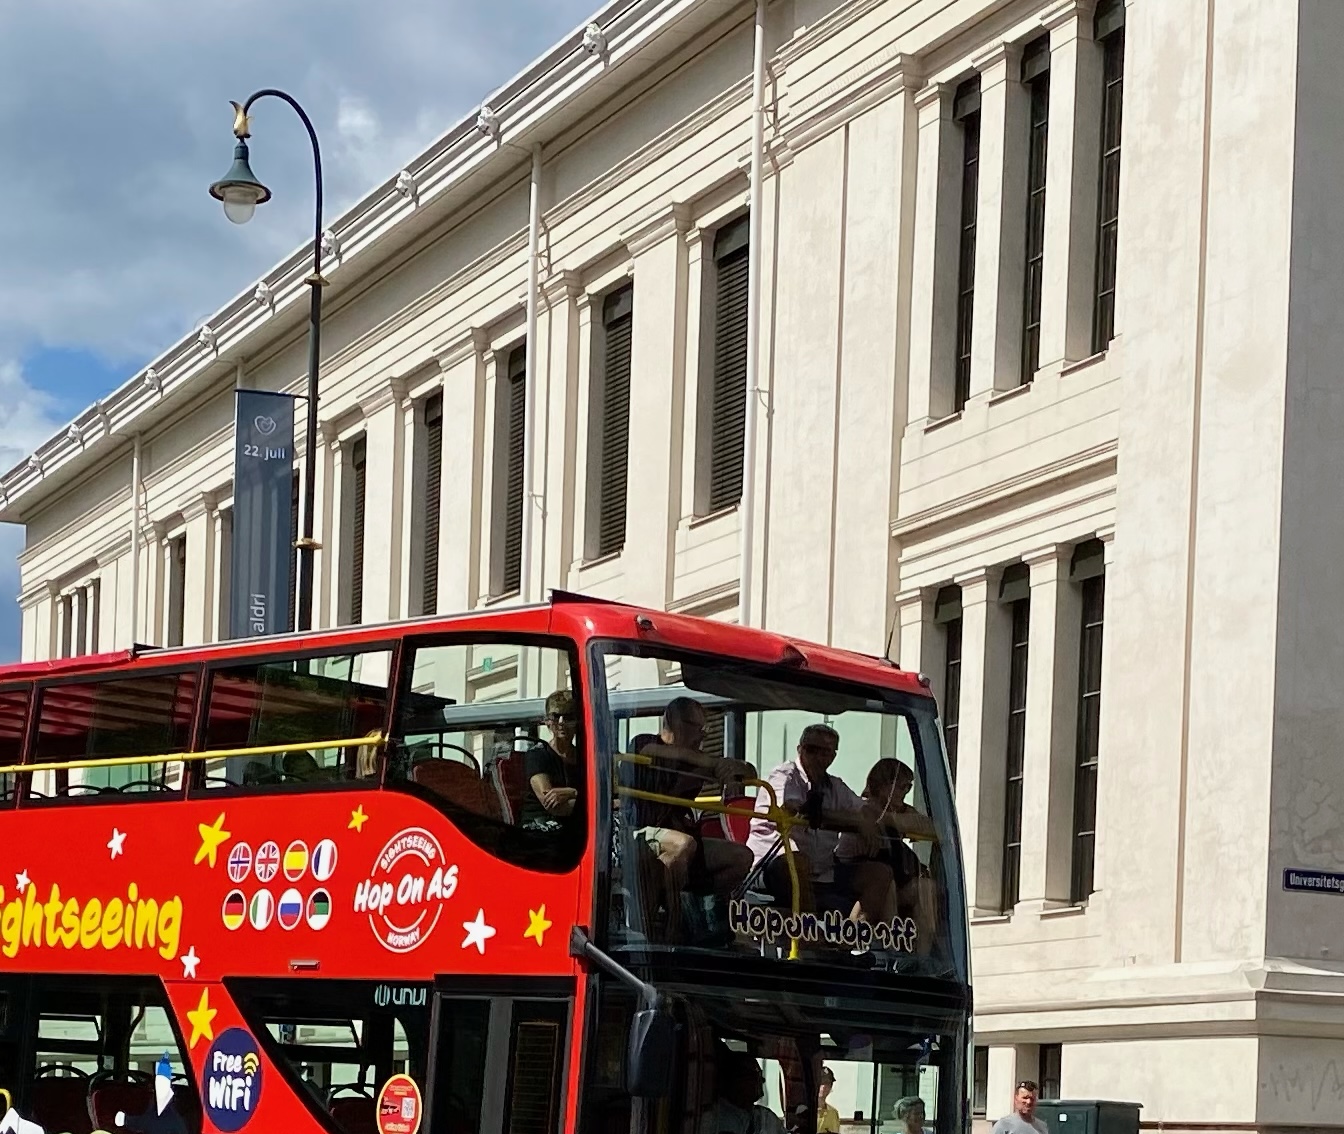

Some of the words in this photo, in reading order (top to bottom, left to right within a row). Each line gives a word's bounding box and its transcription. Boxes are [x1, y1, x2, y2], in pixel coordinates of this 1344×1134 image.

[243, 444, 263, 458] 22.
[264, 446, 286, 460] juli
[249, 592, 267, 633] aldri
[380, 835, 437, 870] SIGHTSEEING
[353, 879, 394, 916] Hop
[397, 873, 425, 905] On
[426, 864, 459, 901] AS
[729, 899, 783, 944] Hop
[784, 913, 818, 941] on
[823, 909, 872, 950] Hop
[874, 915, 917, 953] off
[213, 1050, 243, 1073] Free
[209, 1074, 253, 1111] WiFi
